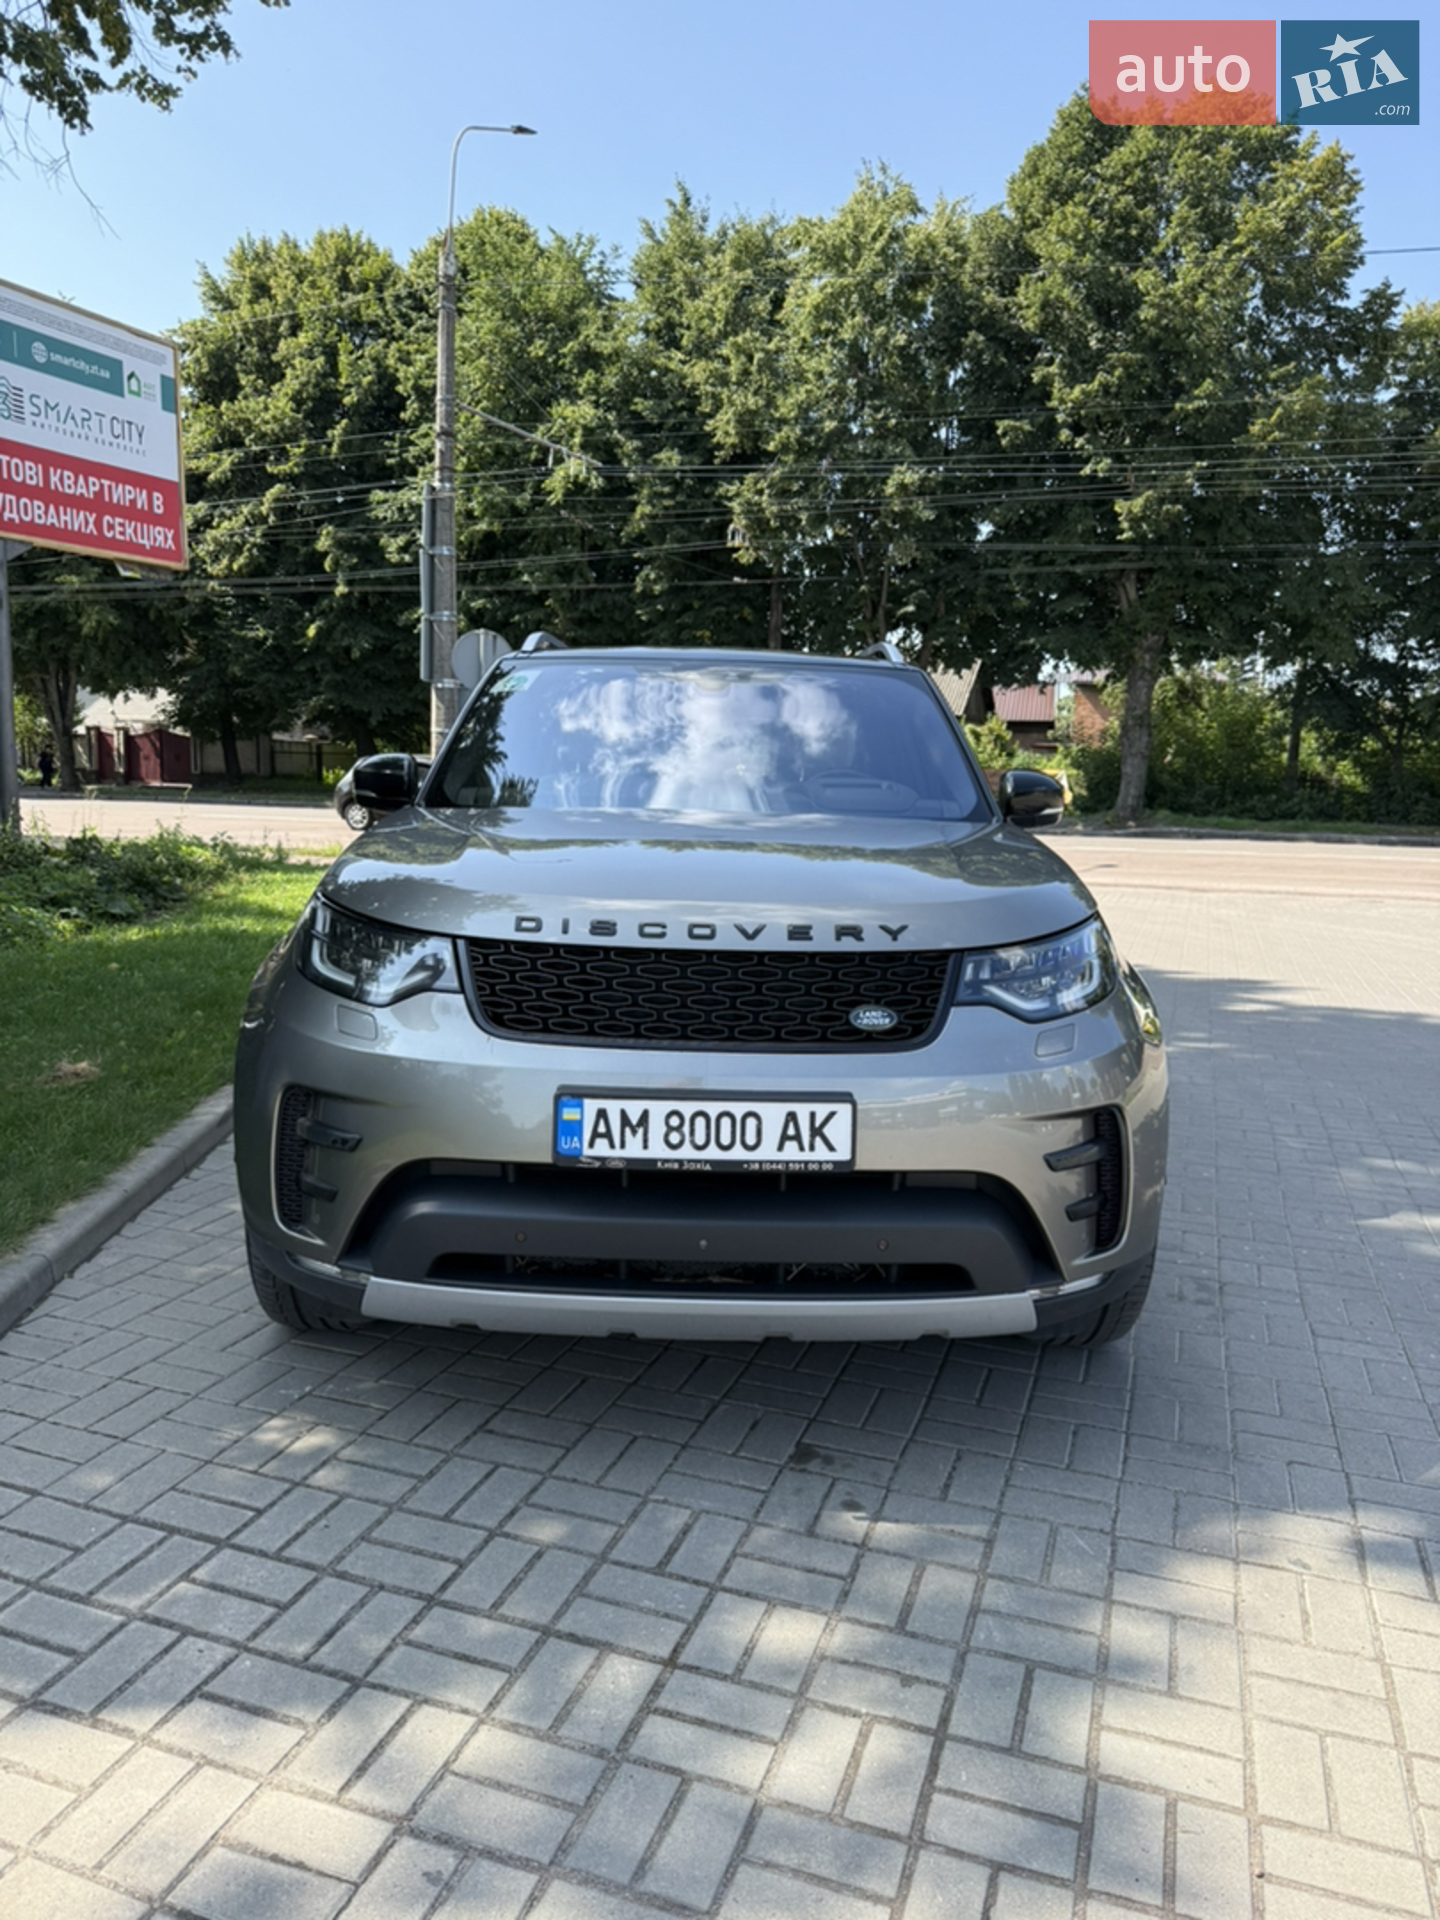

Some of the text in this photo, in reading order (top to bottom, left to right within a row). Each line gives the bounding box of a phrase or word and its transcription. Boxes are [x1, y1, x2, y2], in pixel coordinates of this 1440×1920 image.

[28, 394, 146, 446] SMART CITY
[49, 466, 148, 514] КВАРТИРИ
[152, 491, 165, 515] В
[102, 514, 176, 551] СЕКЦІЯХ
[514, 915, 909, 942] DISCOVERY
[561, 1135, 581, 1149] UA
[588, 1107, 838, 1153] AM 8000 AK
